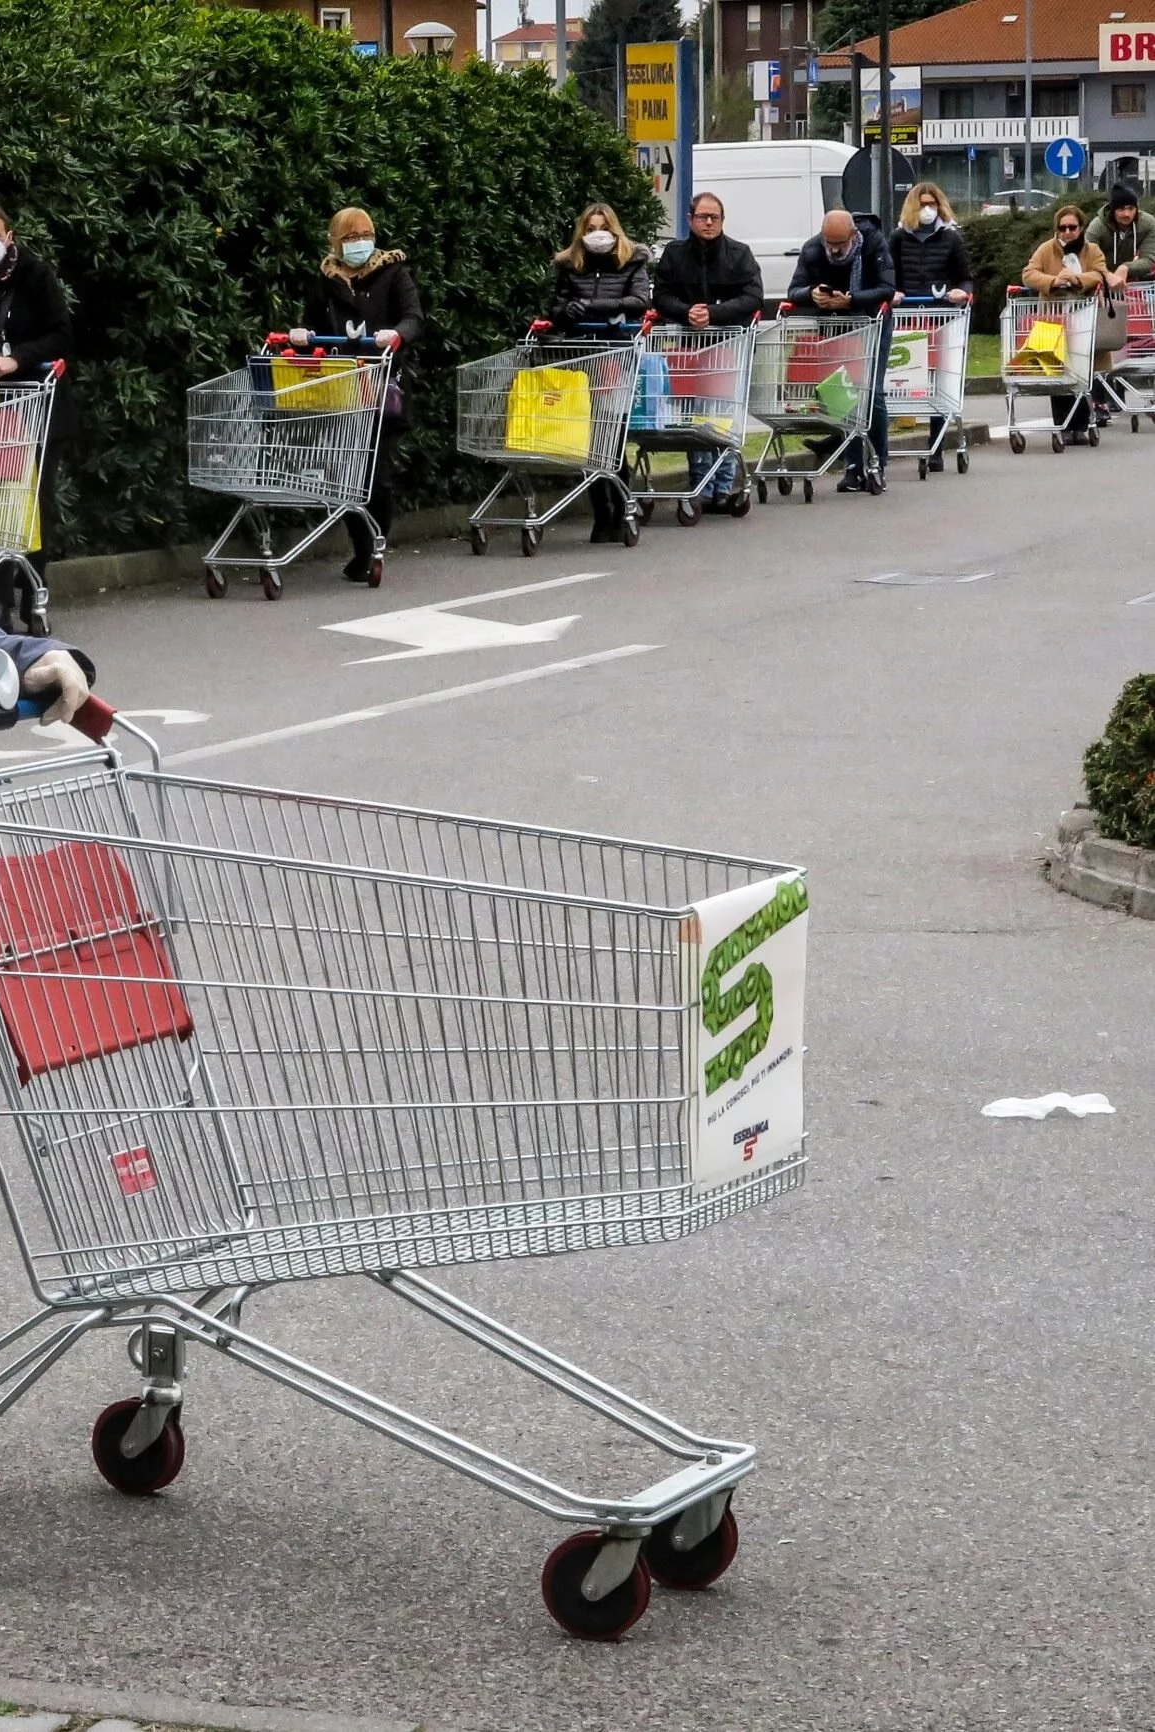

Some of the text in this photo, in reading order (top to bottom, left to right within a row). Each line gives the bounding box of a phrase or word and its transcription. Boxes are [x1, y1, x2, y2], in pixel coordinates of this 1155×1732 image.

[1110, 33, 1155, 61] BR
[627, 62, 674, 85] ESSELUNGA
[642, 99, 668, 121] PAINA
[718, 1105, 725, 1117] LA
[761, 1070, 767, 1080] TI
[733, 1119, 769, 1145] ESSELUNGA
